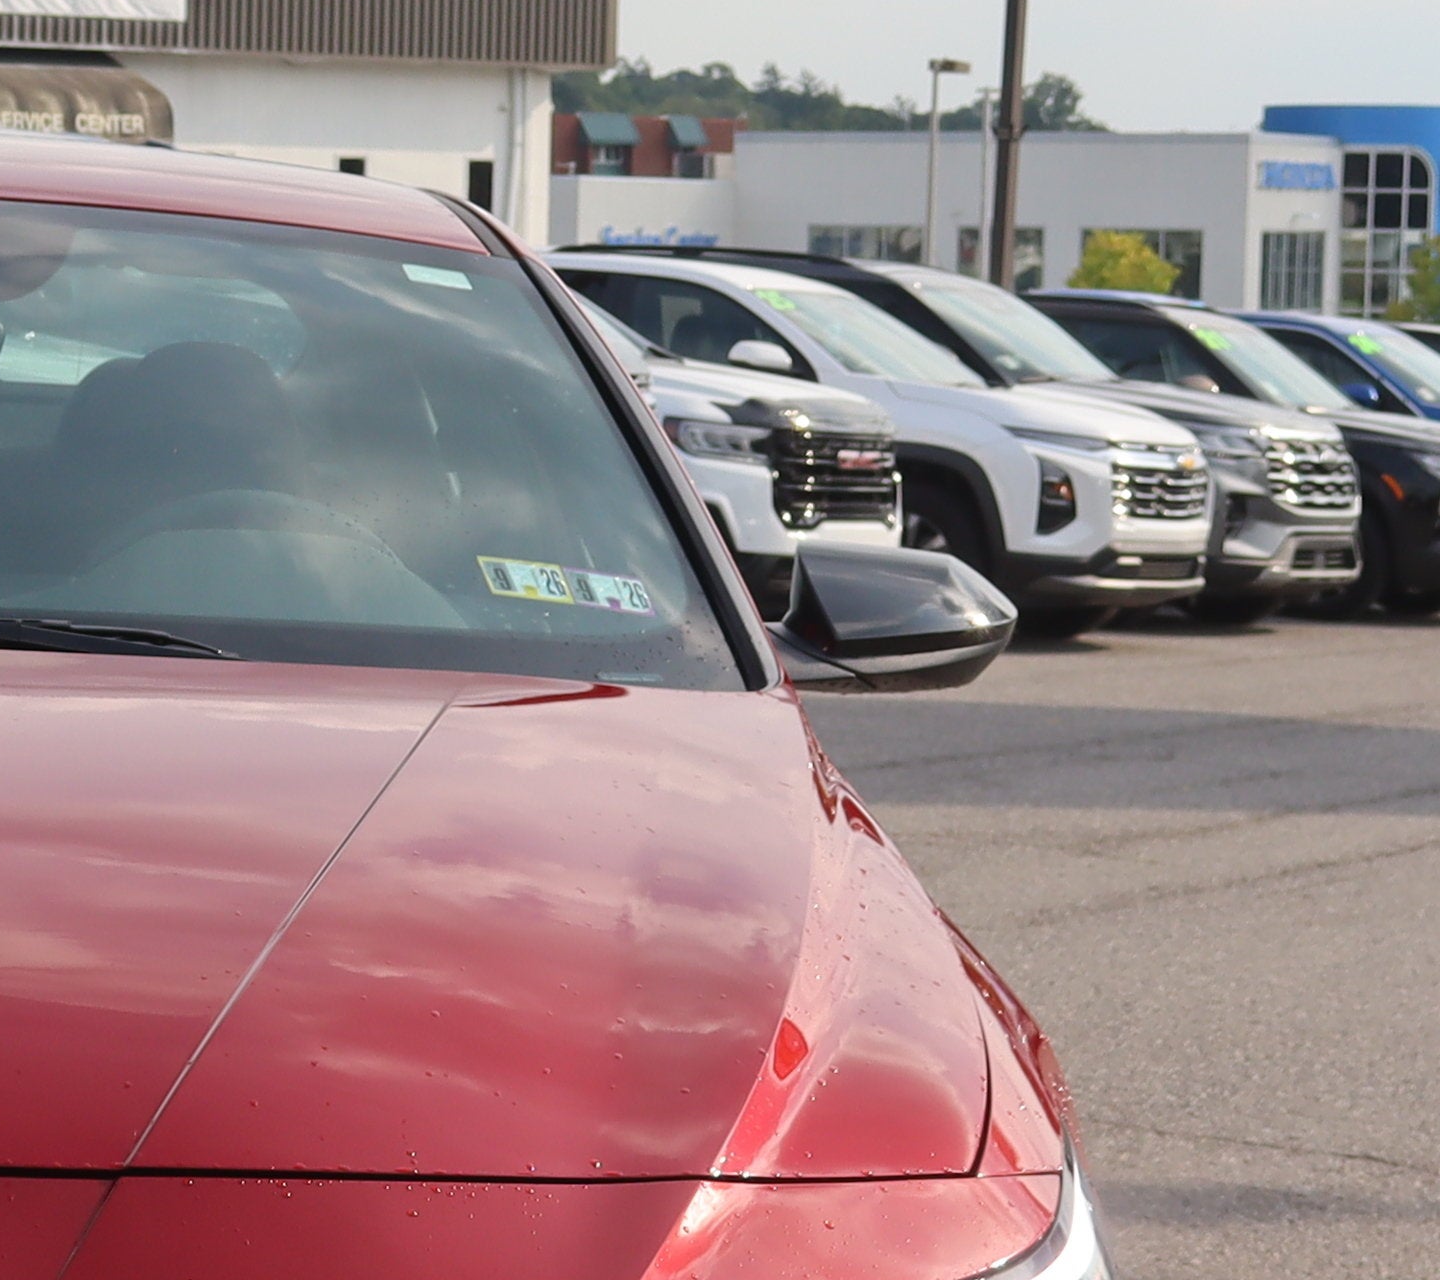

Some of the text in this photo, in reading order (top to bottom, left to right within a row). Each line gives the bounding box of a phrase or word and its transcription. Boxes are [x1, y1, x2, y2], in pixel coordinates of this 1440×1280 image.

[75, 113, 145, 134] CENTER
[540, 568, 567, 597] 26
[622, 580, 650, 609] 26
